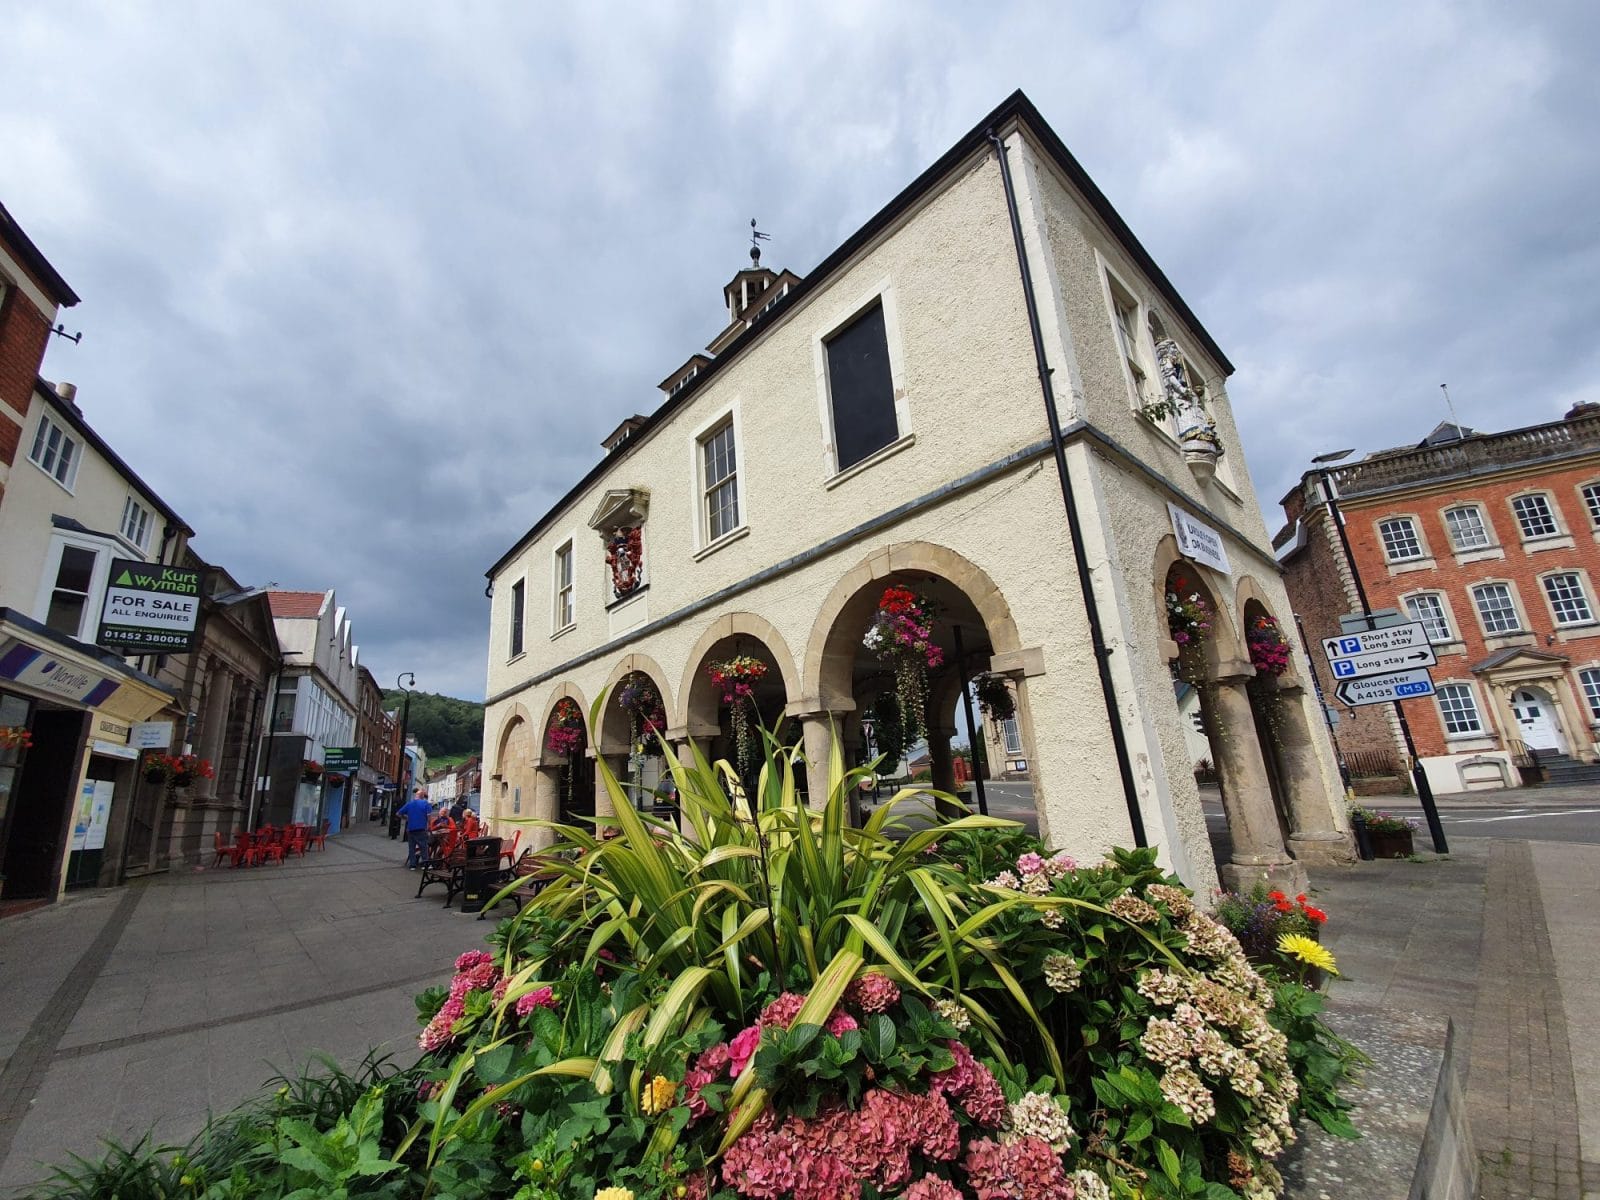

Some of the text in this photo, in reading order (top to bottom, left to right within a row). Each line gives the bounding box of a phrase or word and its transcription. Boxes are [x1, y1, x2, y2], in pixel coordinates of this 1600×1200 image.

[135, 574, 197, 594] Wyman
[161, 568, 198, 584] Kurt
[112, 595, 193, 613] FOR SALE
[111, 608, 189, 622] ALL ENQUIRIES
[104, 630, 142, 640] 01452
[146, 635, 188, 644] 380064
[1360, 627, 1413, 643] Short stay
[1345, 640, 1357, 653] P
[1363, 636, 1412, 651] Long stay
[1339, 655, 1405, 675] P Long stay
[50, 666, 89, 690] Norville
[1352, 675, 1411, 690] Gloucester
[1357, 682, 1429, 700] A4135 (M5)
